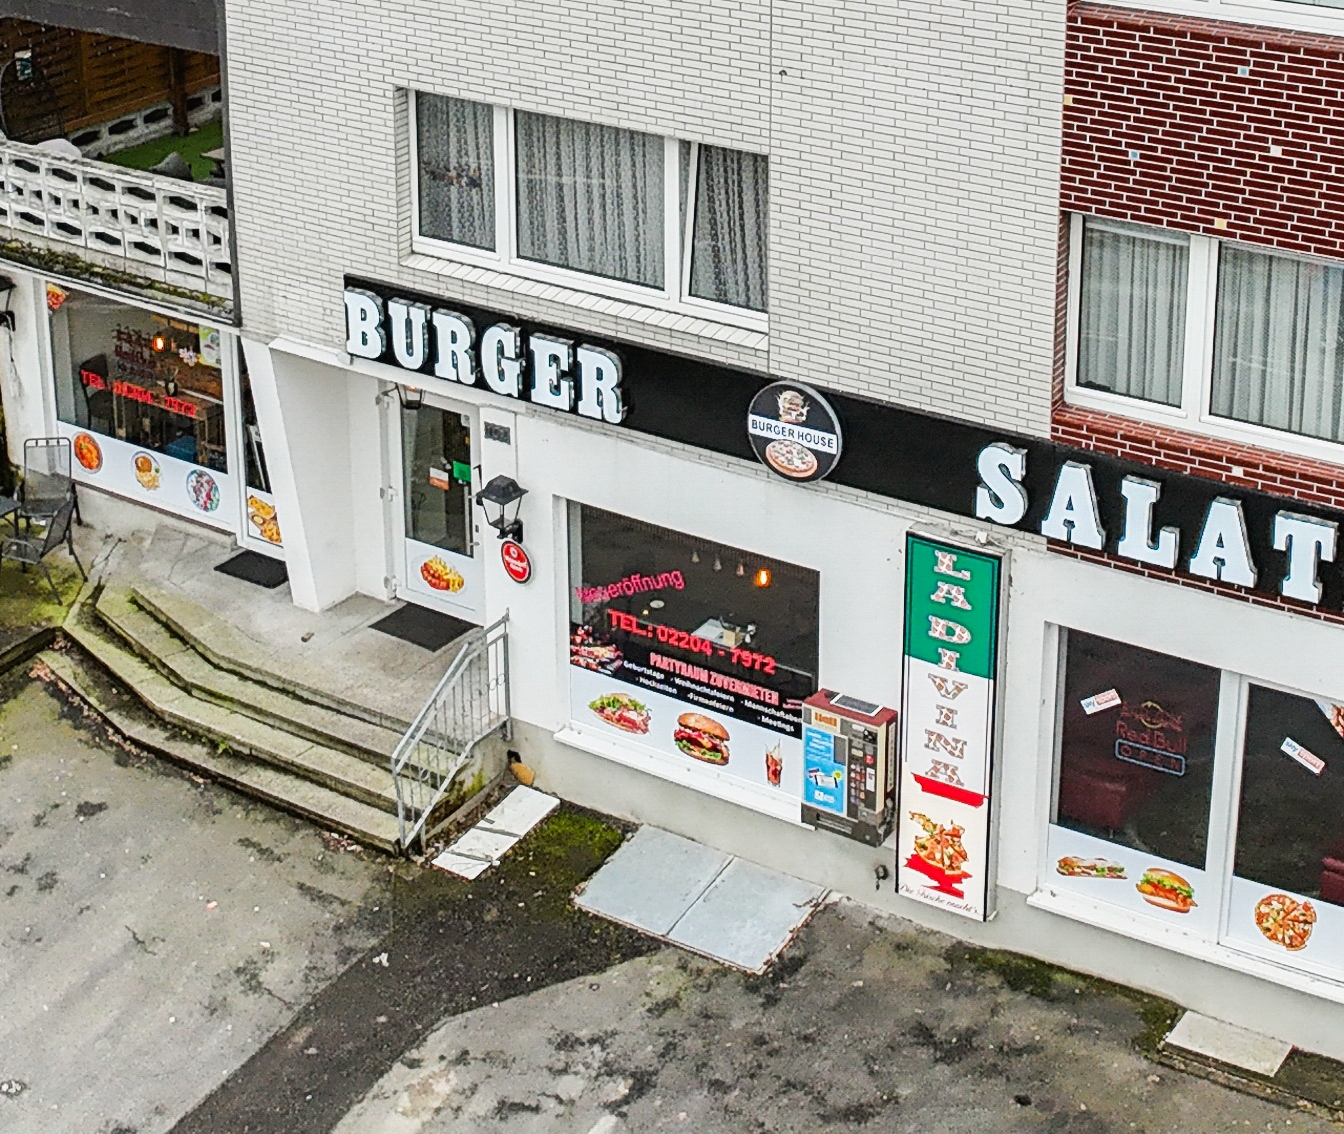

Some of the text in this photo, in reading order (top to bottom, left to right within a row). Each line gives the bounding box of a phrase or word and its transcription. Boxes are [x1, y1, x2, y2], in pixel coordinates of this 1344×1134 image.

[344, 286, 630, 424] BURGER
[751, 419, 834, 448] BURGER HOUSE
[975, 441, 1340, 605] SALAT
[649, 652, 708, 684] PARTYRAUM
[657, 624, 714, 657] 02204
[730, 646, 776, 675] 7972
